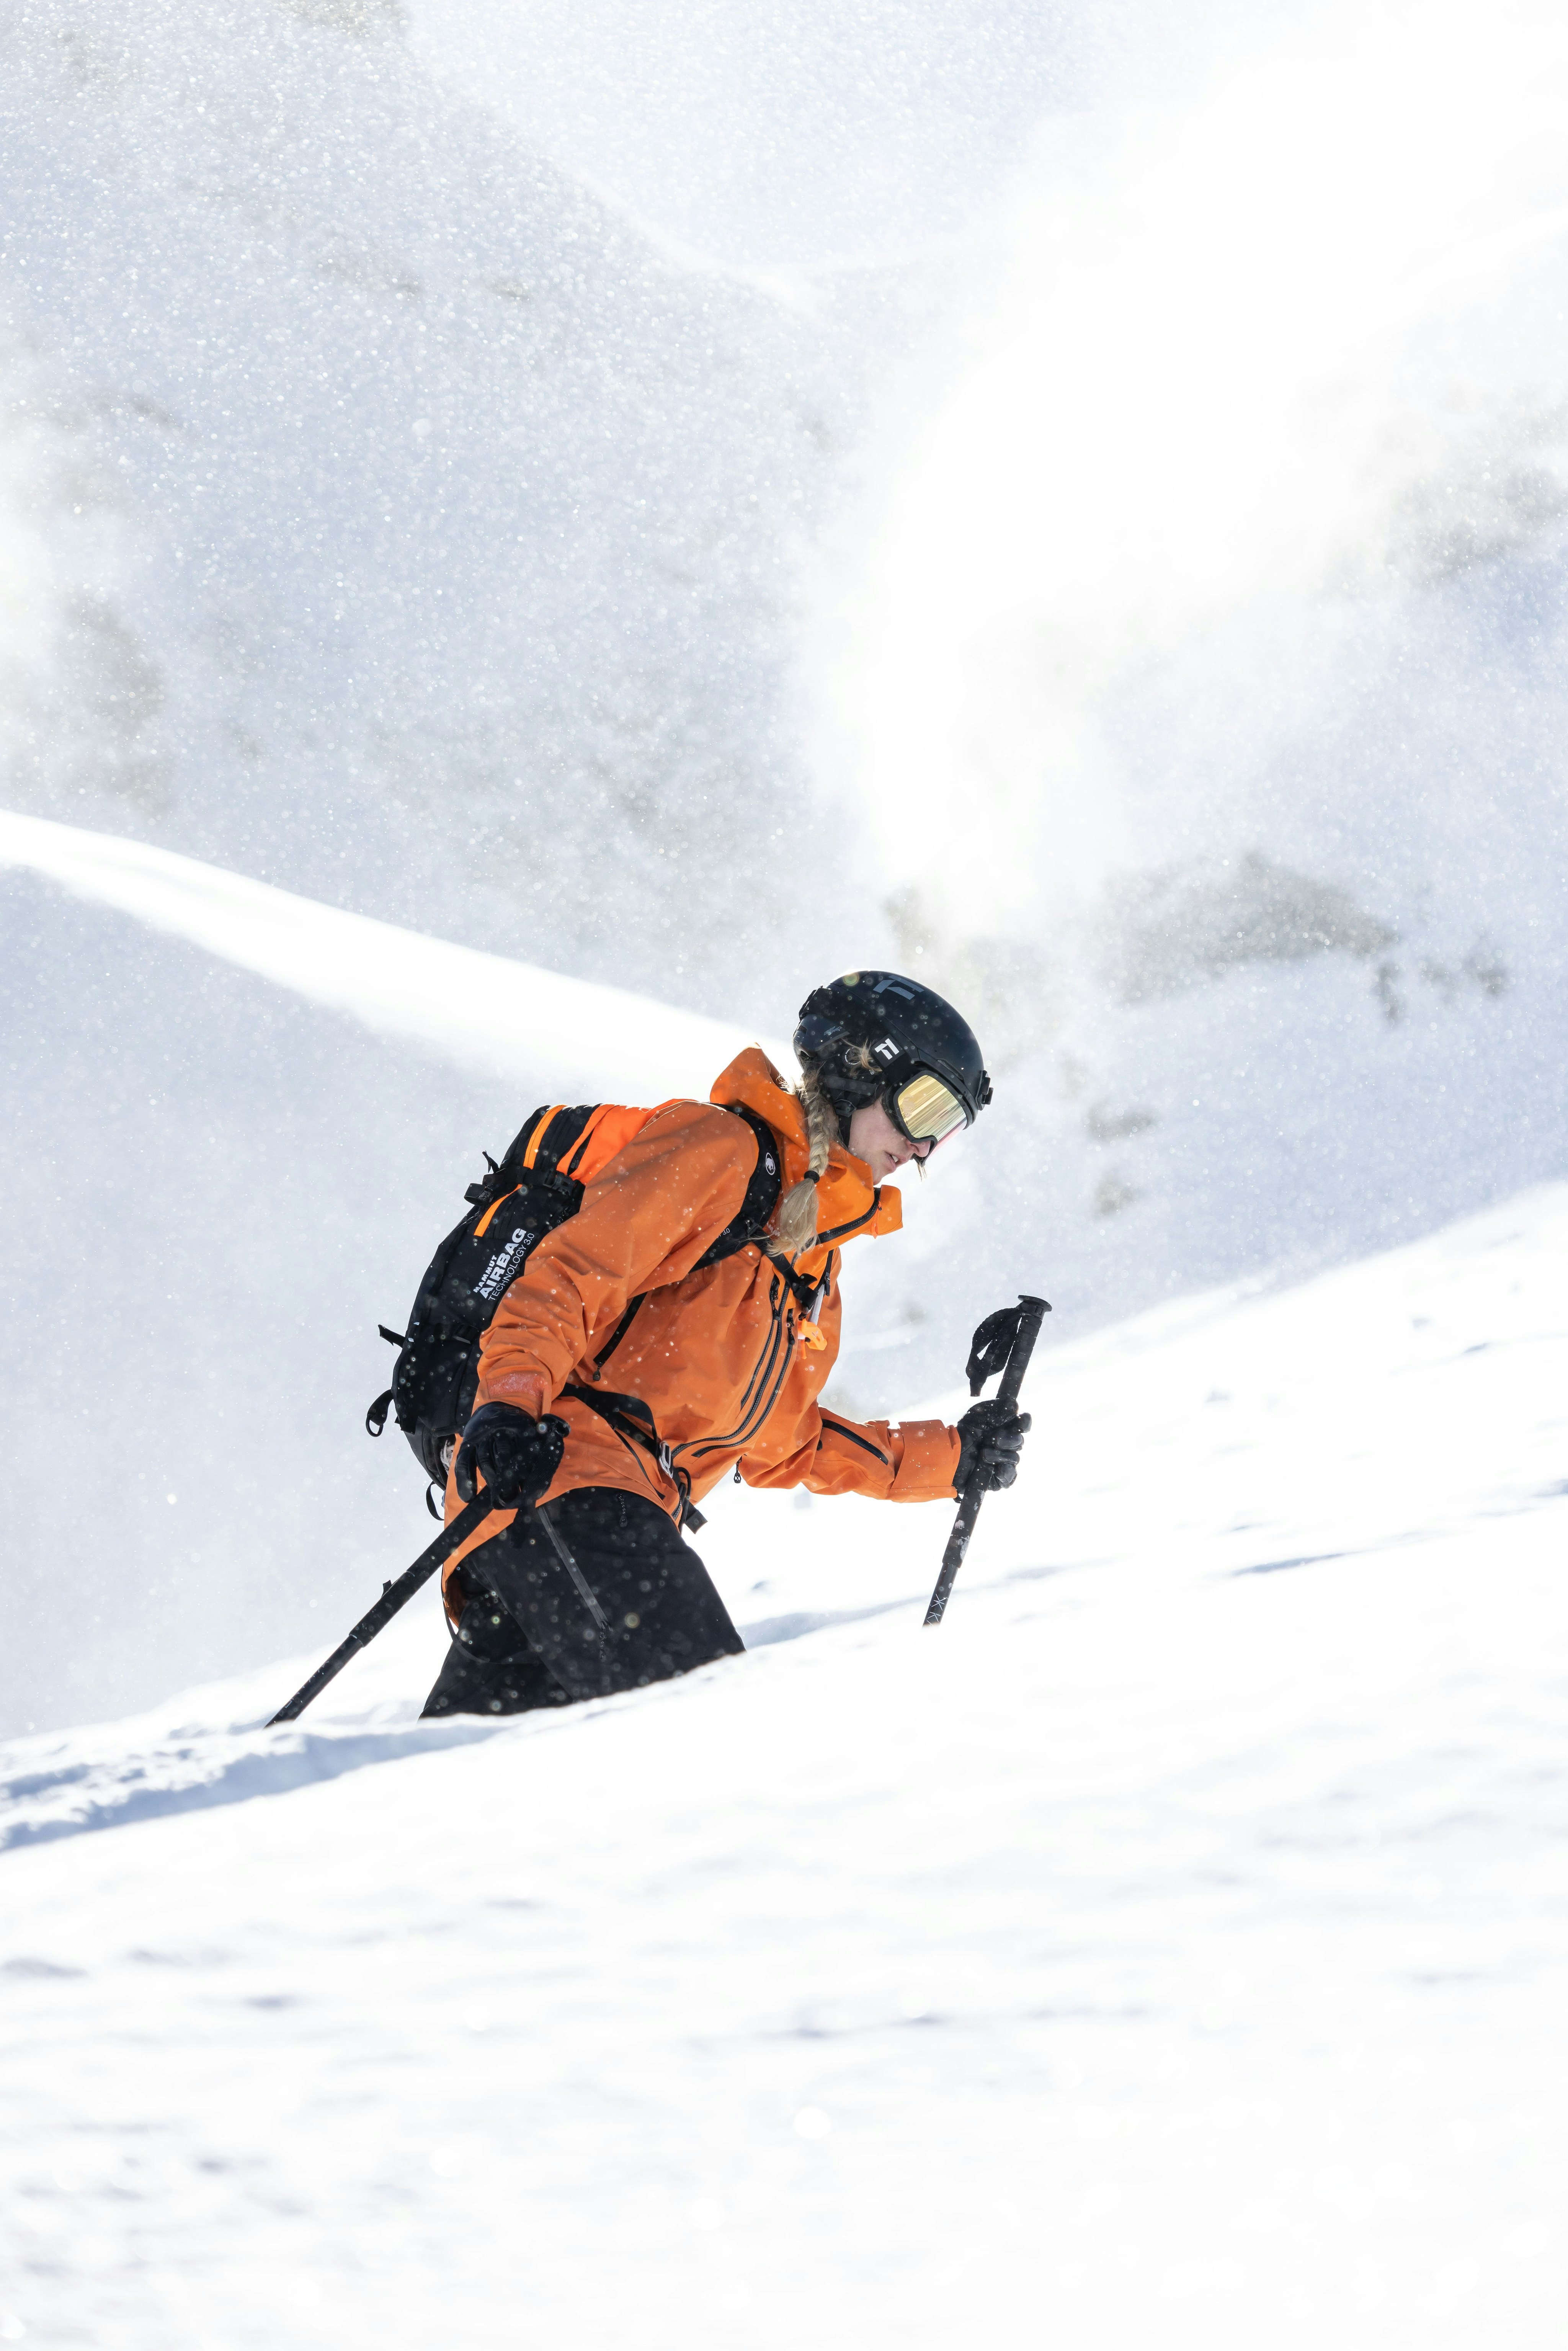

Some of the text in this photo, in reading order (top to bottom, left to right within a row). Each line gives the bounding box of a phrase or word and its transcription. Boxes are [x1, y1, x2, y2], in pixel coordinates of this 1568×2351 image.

[473, 1255, 497, 1293] MAMMUT
[480, 1228, 526, 1299] AIRBAG
[488, 1233, 534, 1300] TECHNOLOGY 3.0
